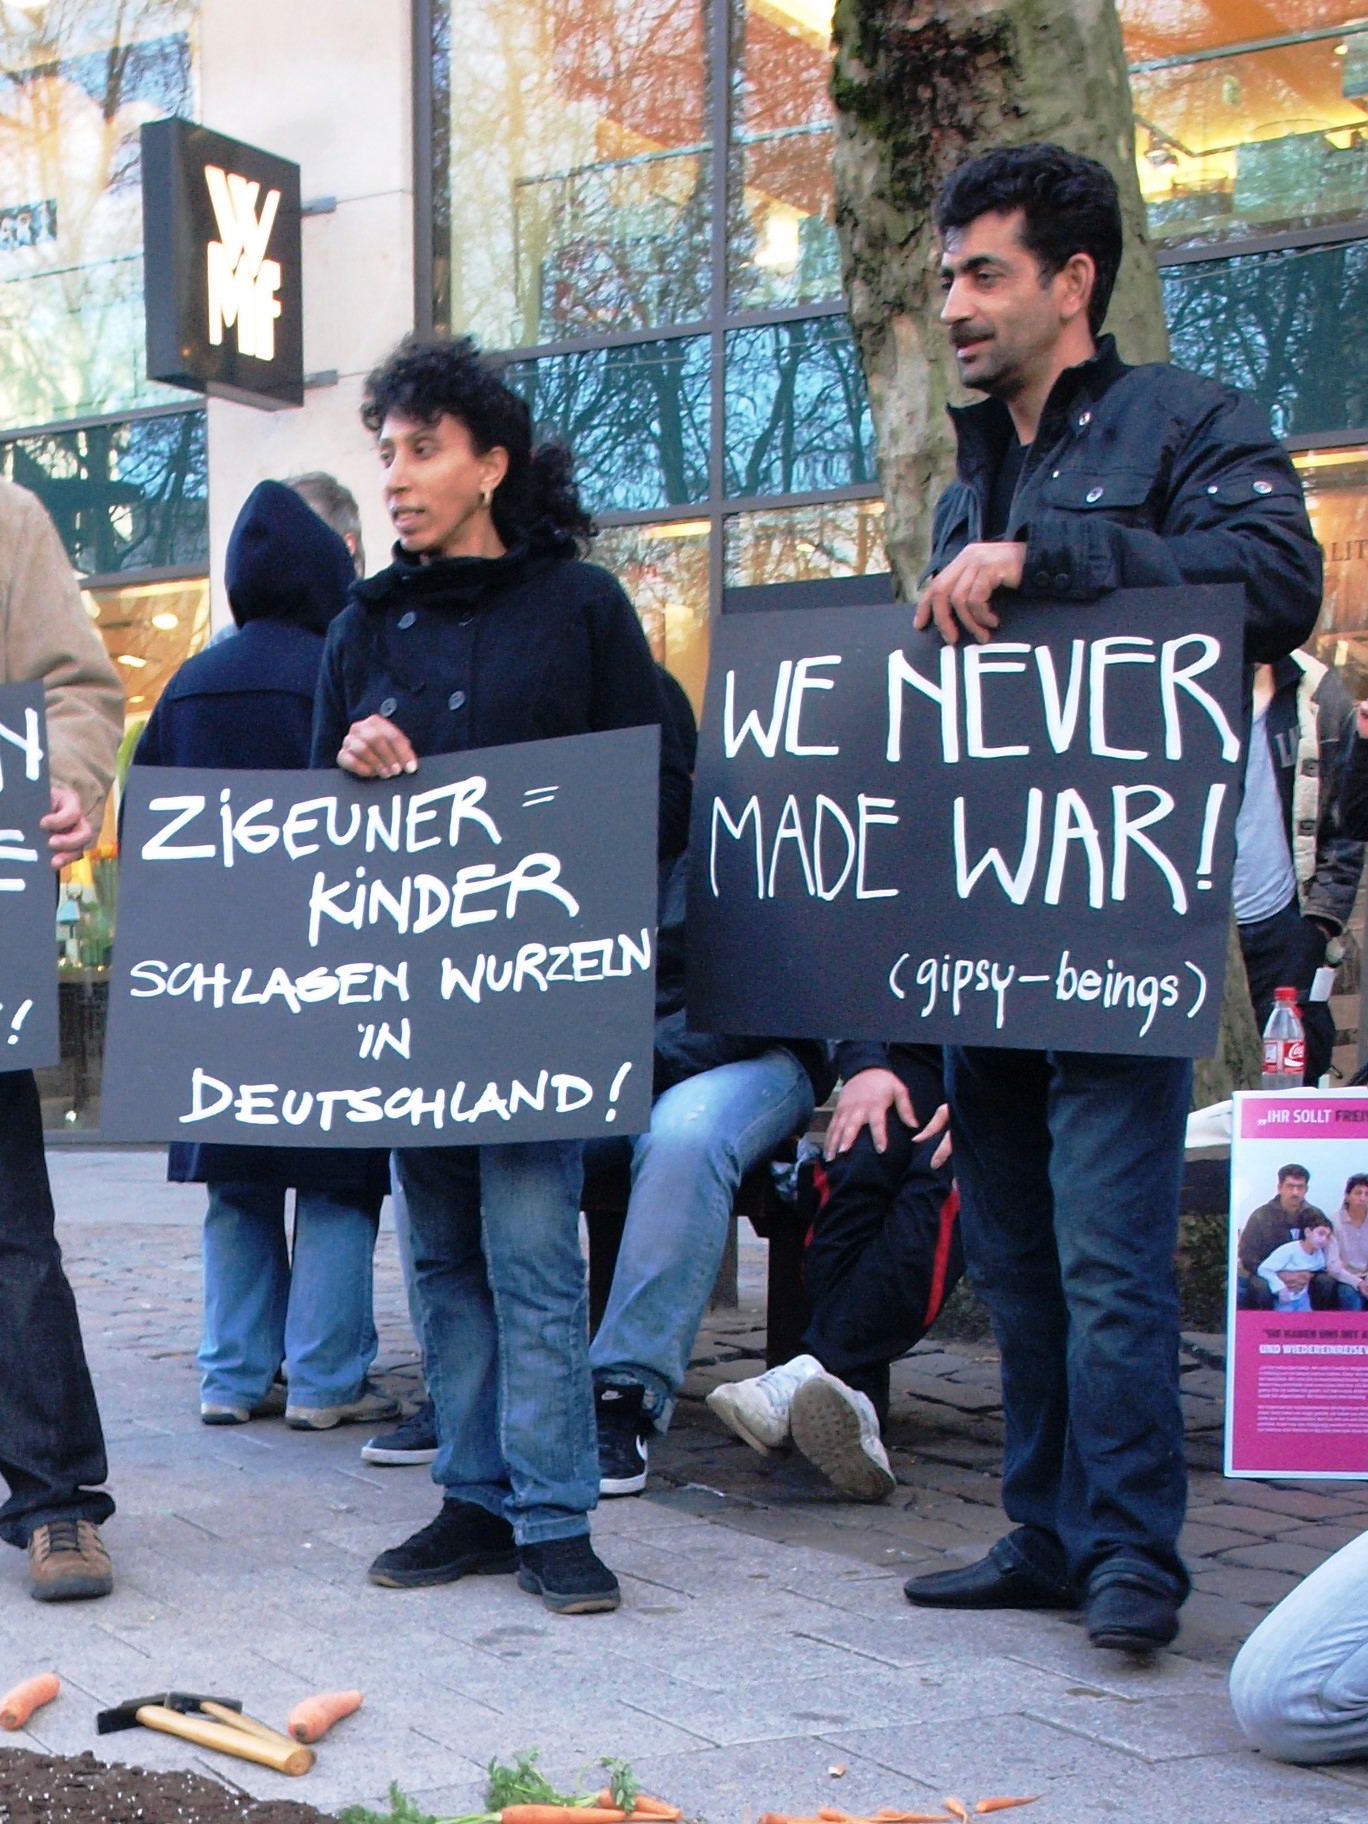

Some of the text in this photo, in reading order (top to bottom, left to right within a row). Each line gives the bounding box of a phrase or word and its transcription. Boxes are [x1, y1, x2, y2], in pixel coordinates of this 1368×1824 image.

[725, 633, 1240, 764] WE NEVER
[709, 783, 1226, 915] MADE WAR!
[129, 927, 652, 1014] SCHLAGEN WURZELN
[889, 950, 1207, 1038] (gipsy-beings)
[178, 1061, 632, 1132] DEUTSCHLAND!
[1293, 1108, 1332, 1124] SOLLT
